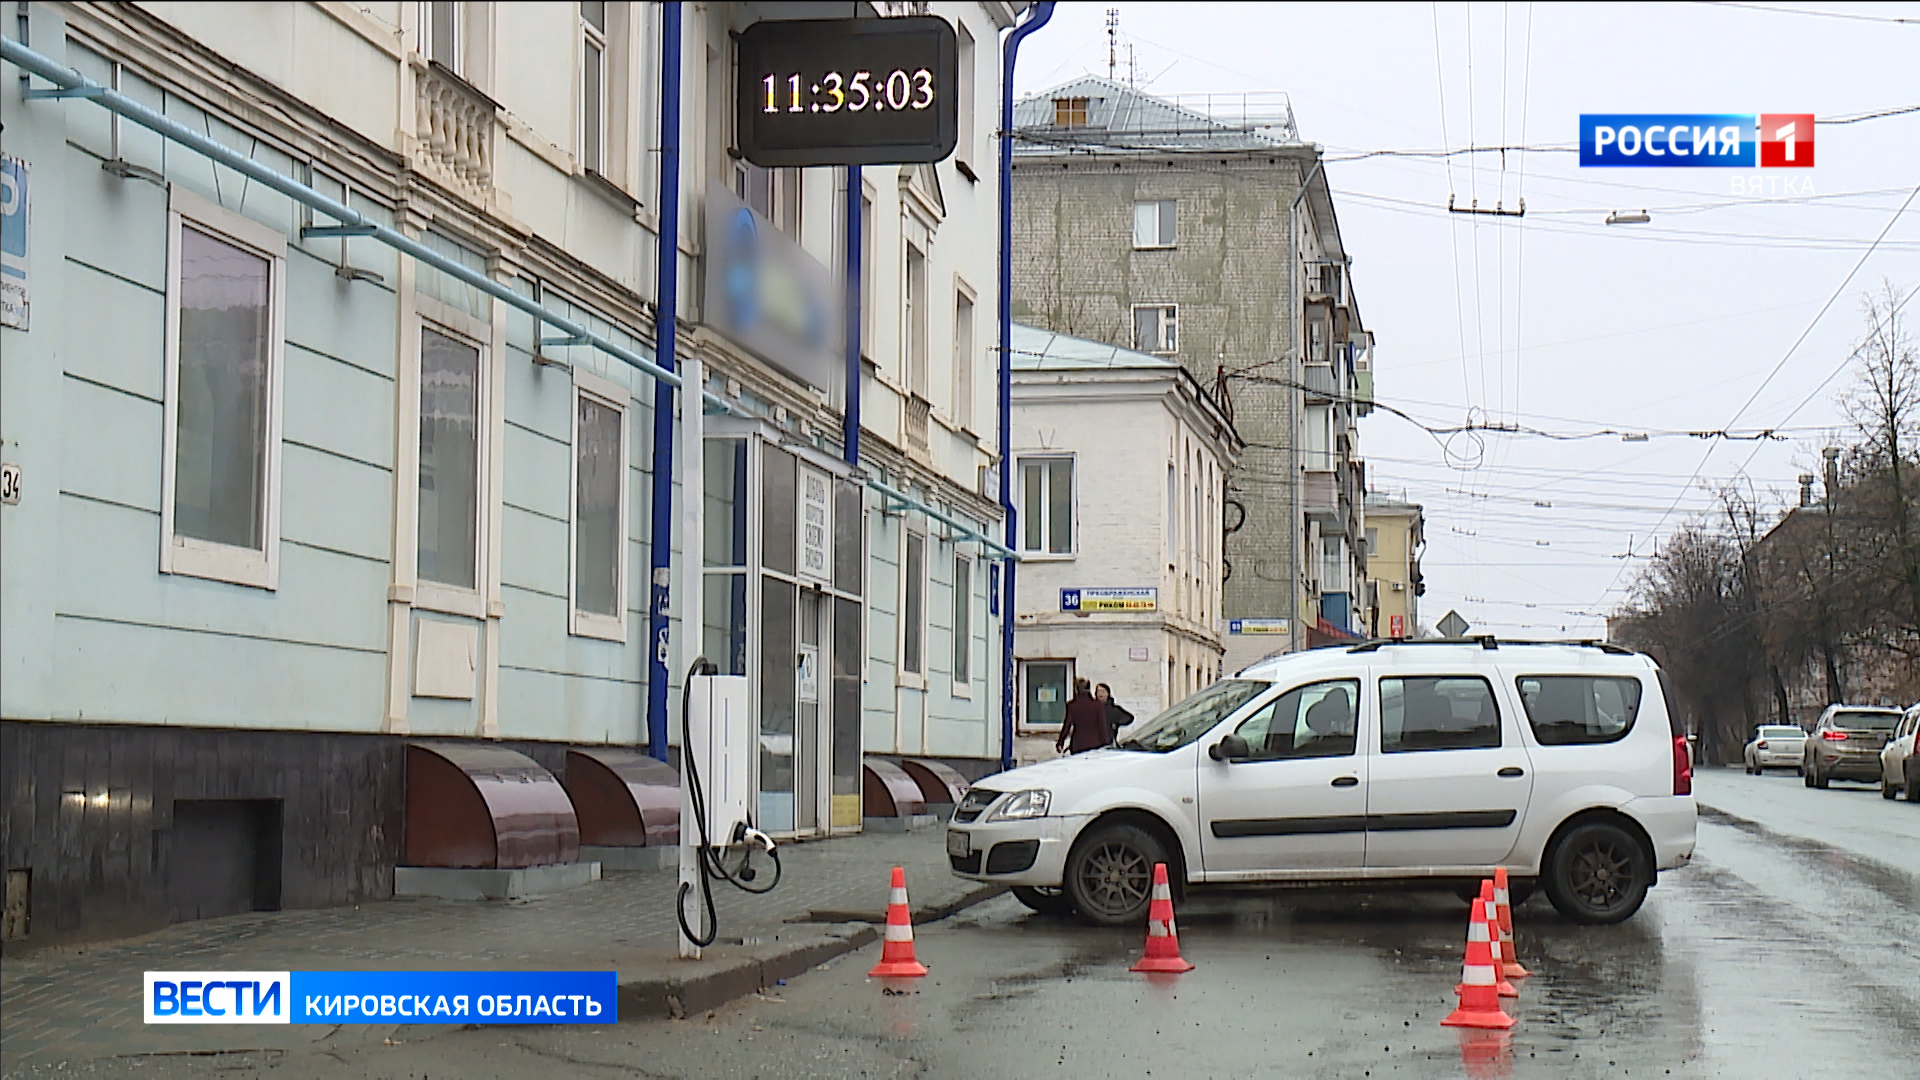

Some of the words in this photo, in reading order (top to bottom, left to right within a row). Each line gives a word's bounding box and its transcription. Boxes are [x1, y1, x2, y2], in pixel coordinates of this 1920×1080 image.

[762, 69, 935, 113] 11:35:03
[3, 470, 19, 500] 34
[1064, 593, 1079, 606] 36
